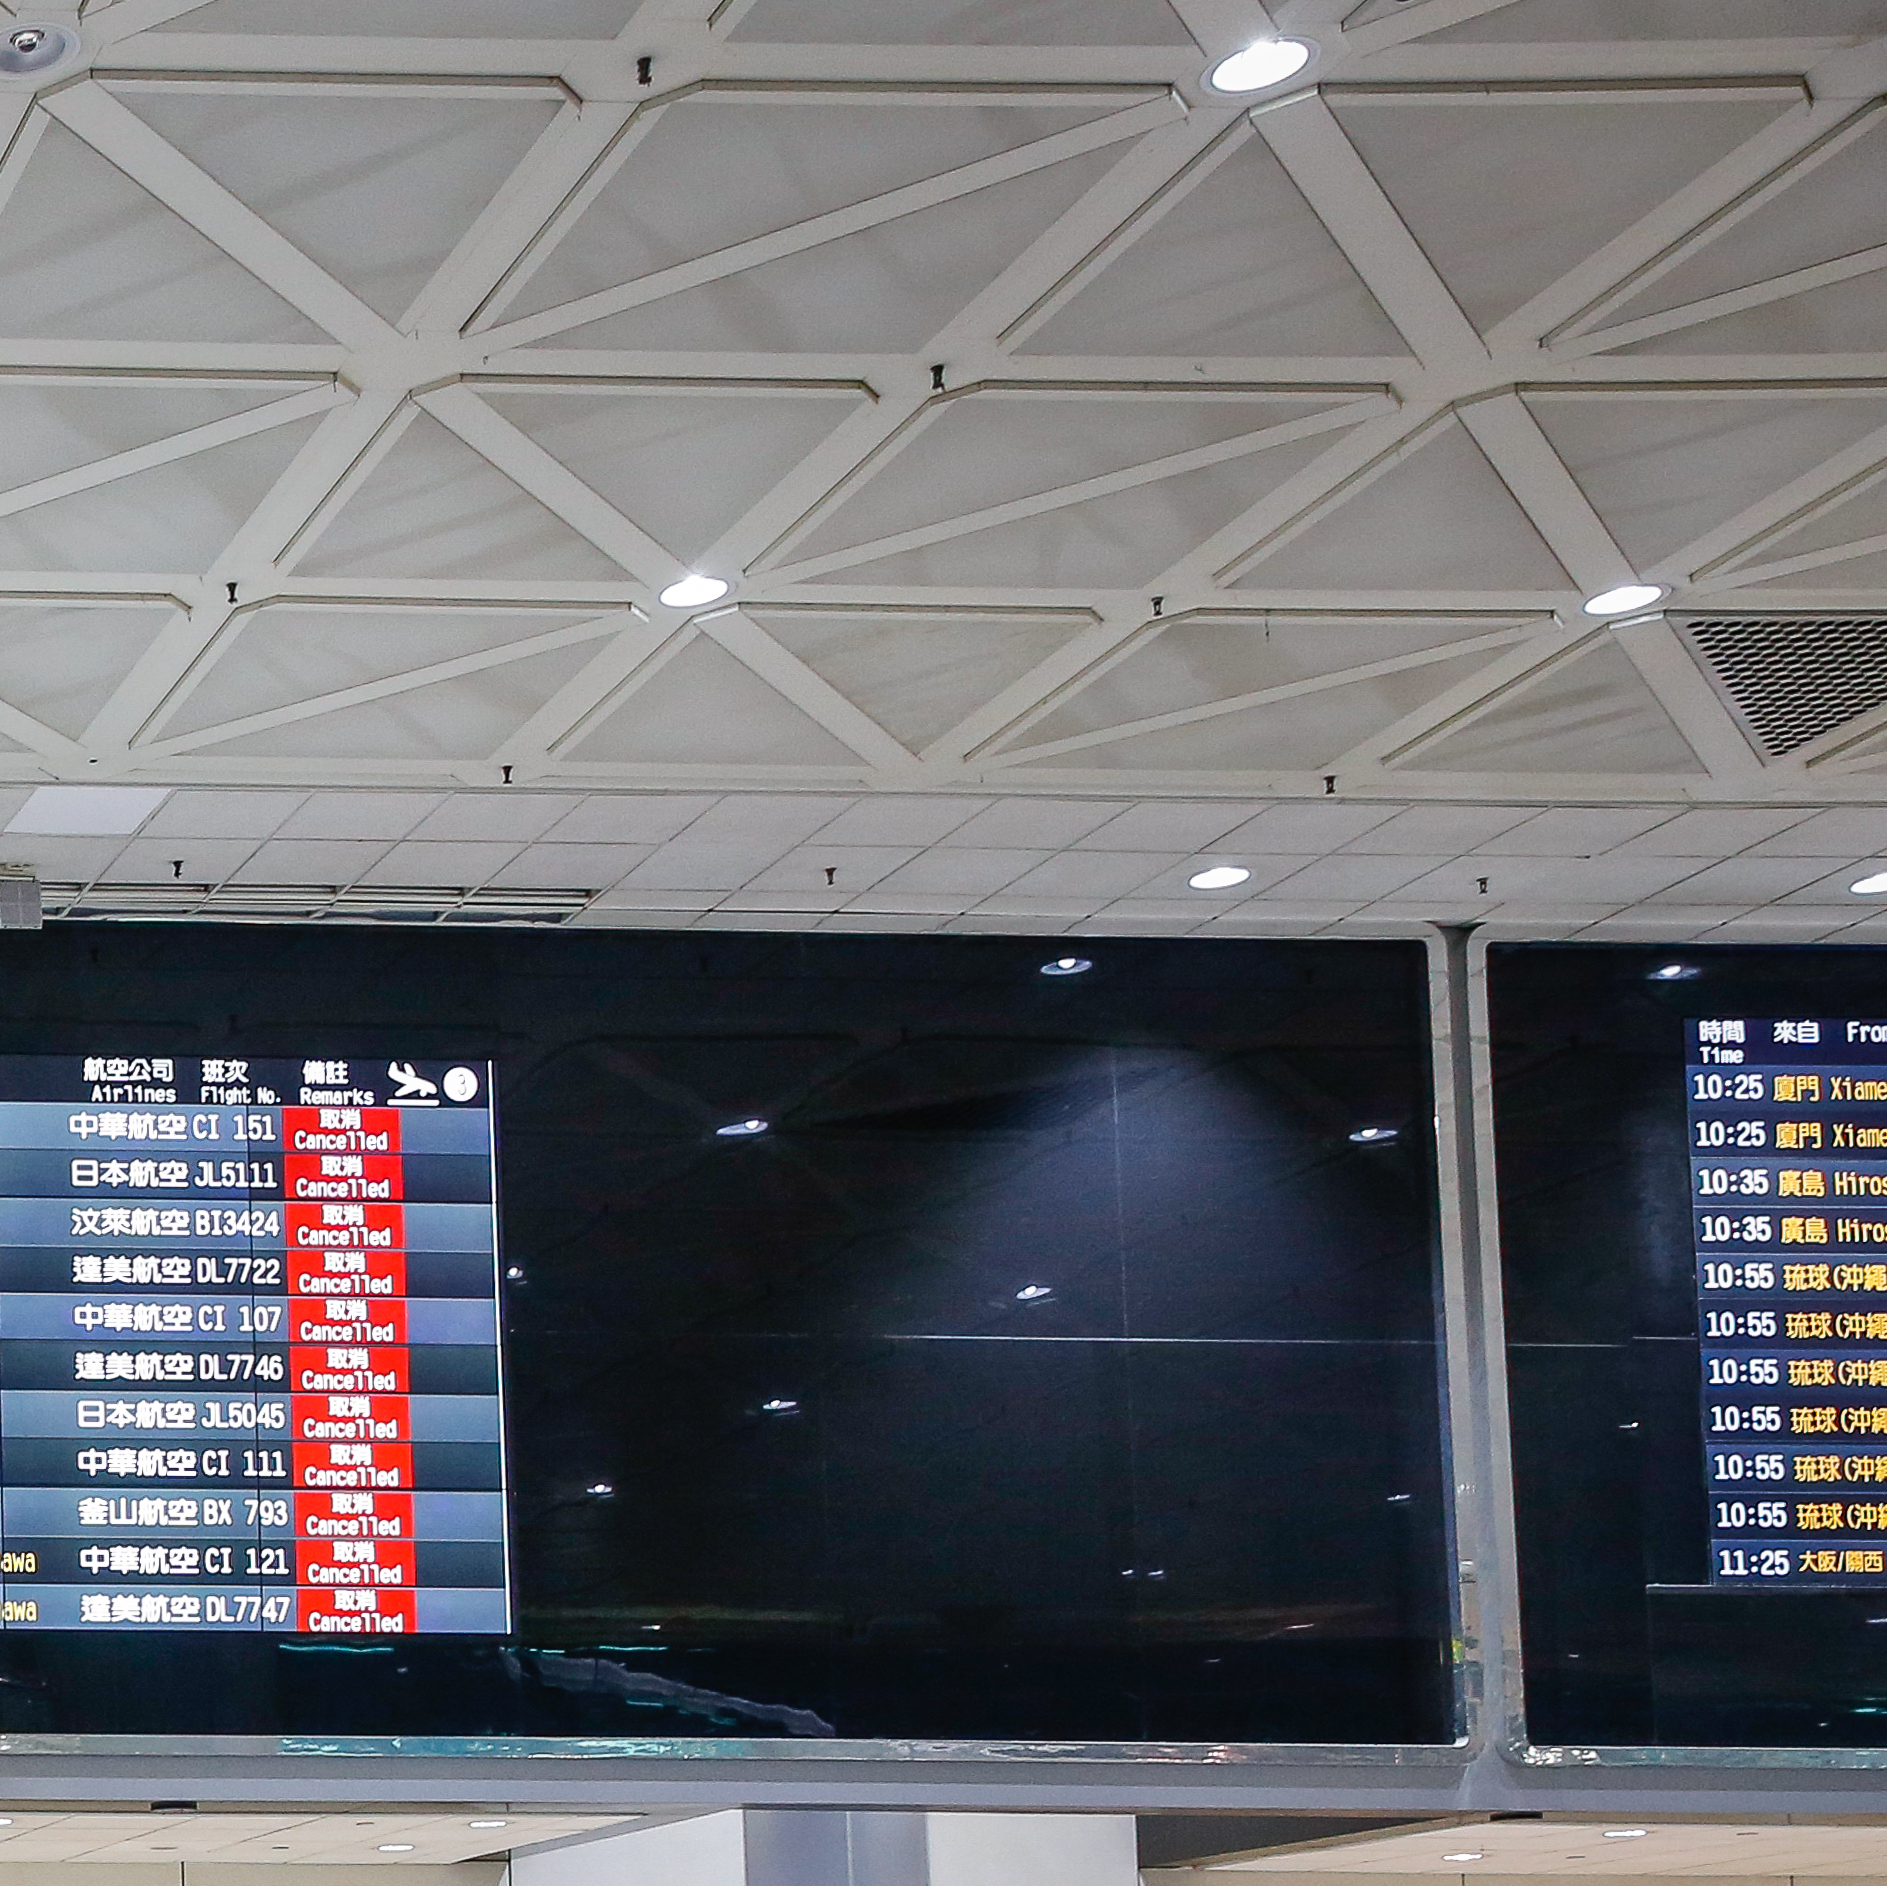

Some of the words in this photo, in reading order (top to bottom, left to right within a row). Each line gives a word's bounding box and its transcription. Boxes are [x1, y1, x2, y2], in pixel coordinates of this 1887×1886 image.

[1698, 1019, 1746, 1044] 時間
[1773, 1019, 1820, 1044] 來自
[1699, 1046, 1744, 1064] Time
[83, 1057, 174, 1087] 航空公司
[201, 1059, 249, 1083] 班次
[302, 1060, 349, 1085] 備註
[88, 1084, 177, 1107] Airlines
[197, 1085, 252, 1108] Flight
[257, 1086, 281, 1105] No.
[299, 1087, 375, 1109] Remarks
[1693, 1074, 1764, 1100] 10:25
[1773, 1074, 1820, 1102] 廈門
[69, 1111, 187, 1140] 中華航空
[192, 1114, 220, 1140] CI
[233, 1114, 276, 1141] 151
[319, 1108, 361, 1130] 取消
[294, 1127, 388, 1151] Cancelled
[1698, 1168, 1769, 1195] 10:35
[1778, 1169, 1825, 1197] 廣島
[71, 1207, 190, 1236] 汶萊航空
[195, 1209, 280, 1237] BI3424
[322, 1204, 364, 1226] 取消
[297, 1223, 391, 1247] Cancelled
[77, 1399, 196, 1429] 日本航空
[201, 1401, 285, 1429] JL5045
[328, 1397, 371, 1421] 取消
[303, 1418, 398, 1439] Cancelled
[77, 1447, 197, 1477] 中華航空
[202, 1449, 230, 1476] CI
[243, 1450, 287, 1477] 111
[330, 1446, 373, 1470] 取消
[304, 1466, 399, 1487] Cancelled
[1719, 1549, 1790, 1576] 11:25
[1798, 1550, 1883, 1573] 大阪/關西
